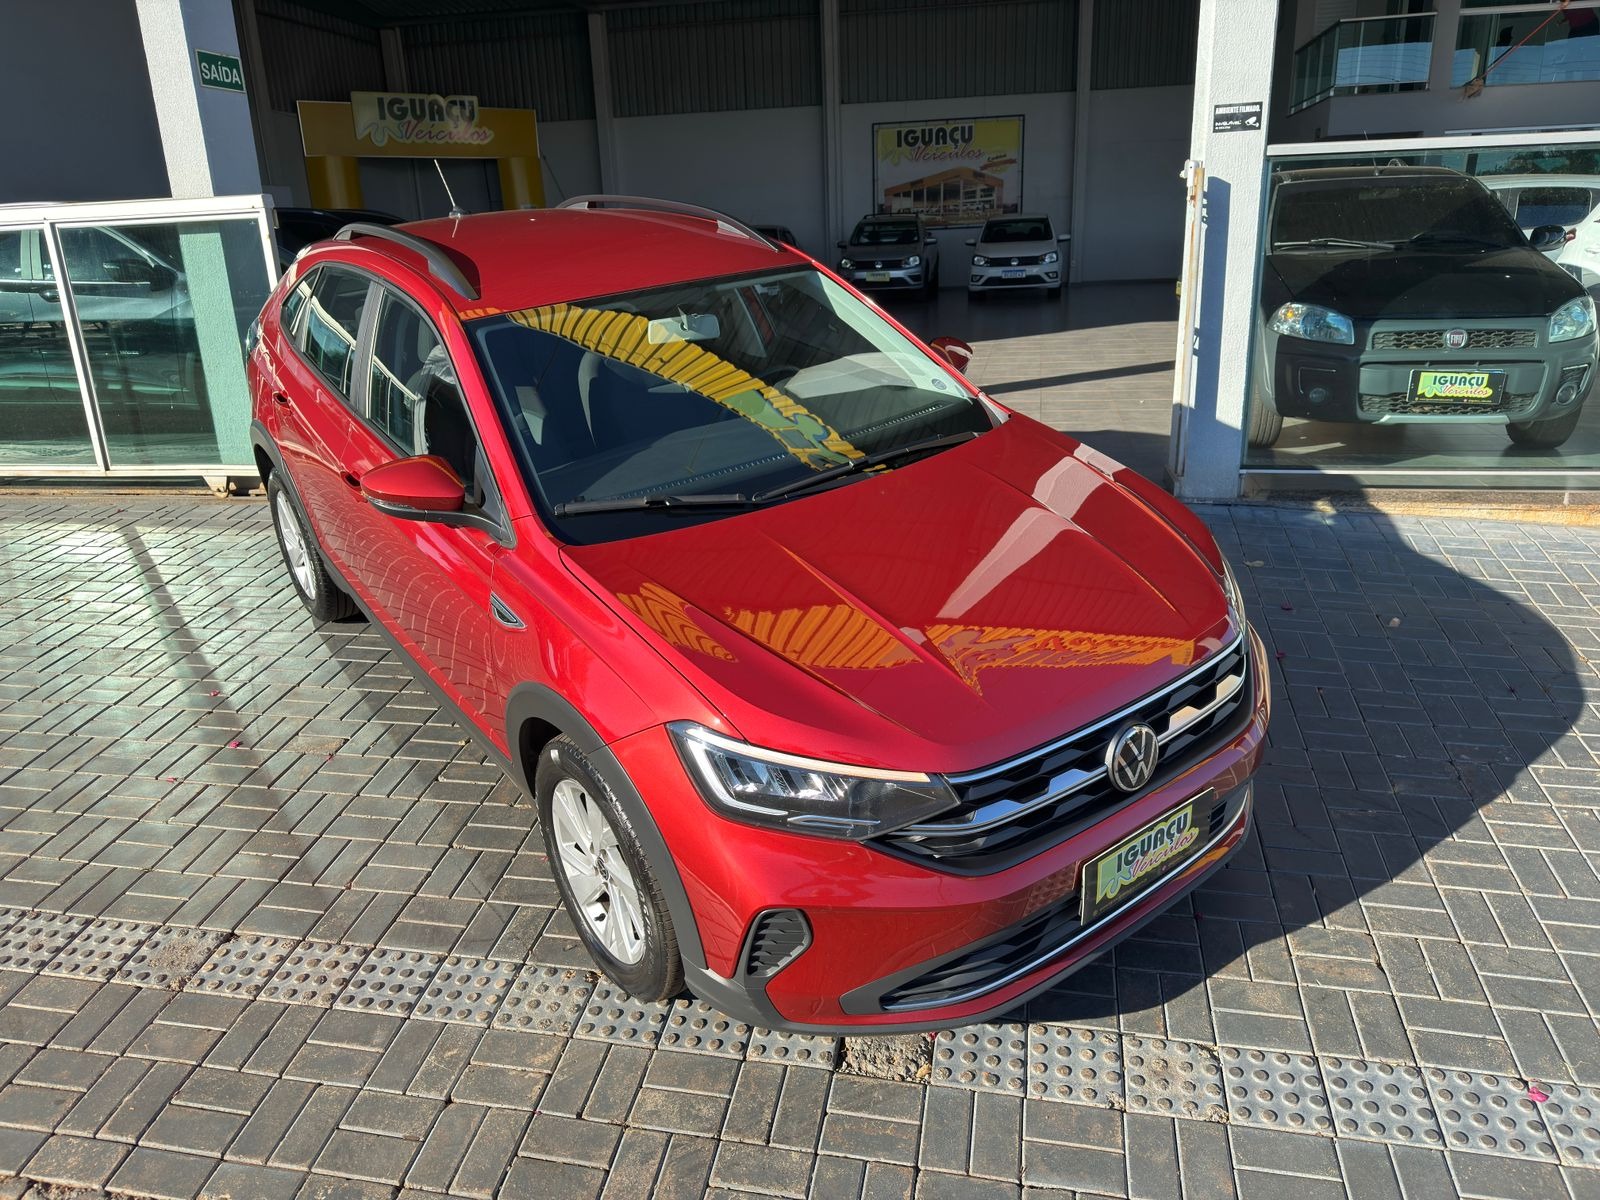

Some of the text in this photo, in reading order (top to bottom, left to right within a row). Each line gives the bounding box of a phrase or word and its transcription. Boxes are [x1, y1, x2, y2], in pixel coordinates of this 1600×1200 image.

[200, 61, 242, 85] SAÍDA
[377, 97, 475, 128] IGUAÇU
[896, 125, 974, 149] IGUAÇU
[1432, 375, 1486, 388] IGUAÇU
[1116, 812, 1189, 873] IGUAÇU
